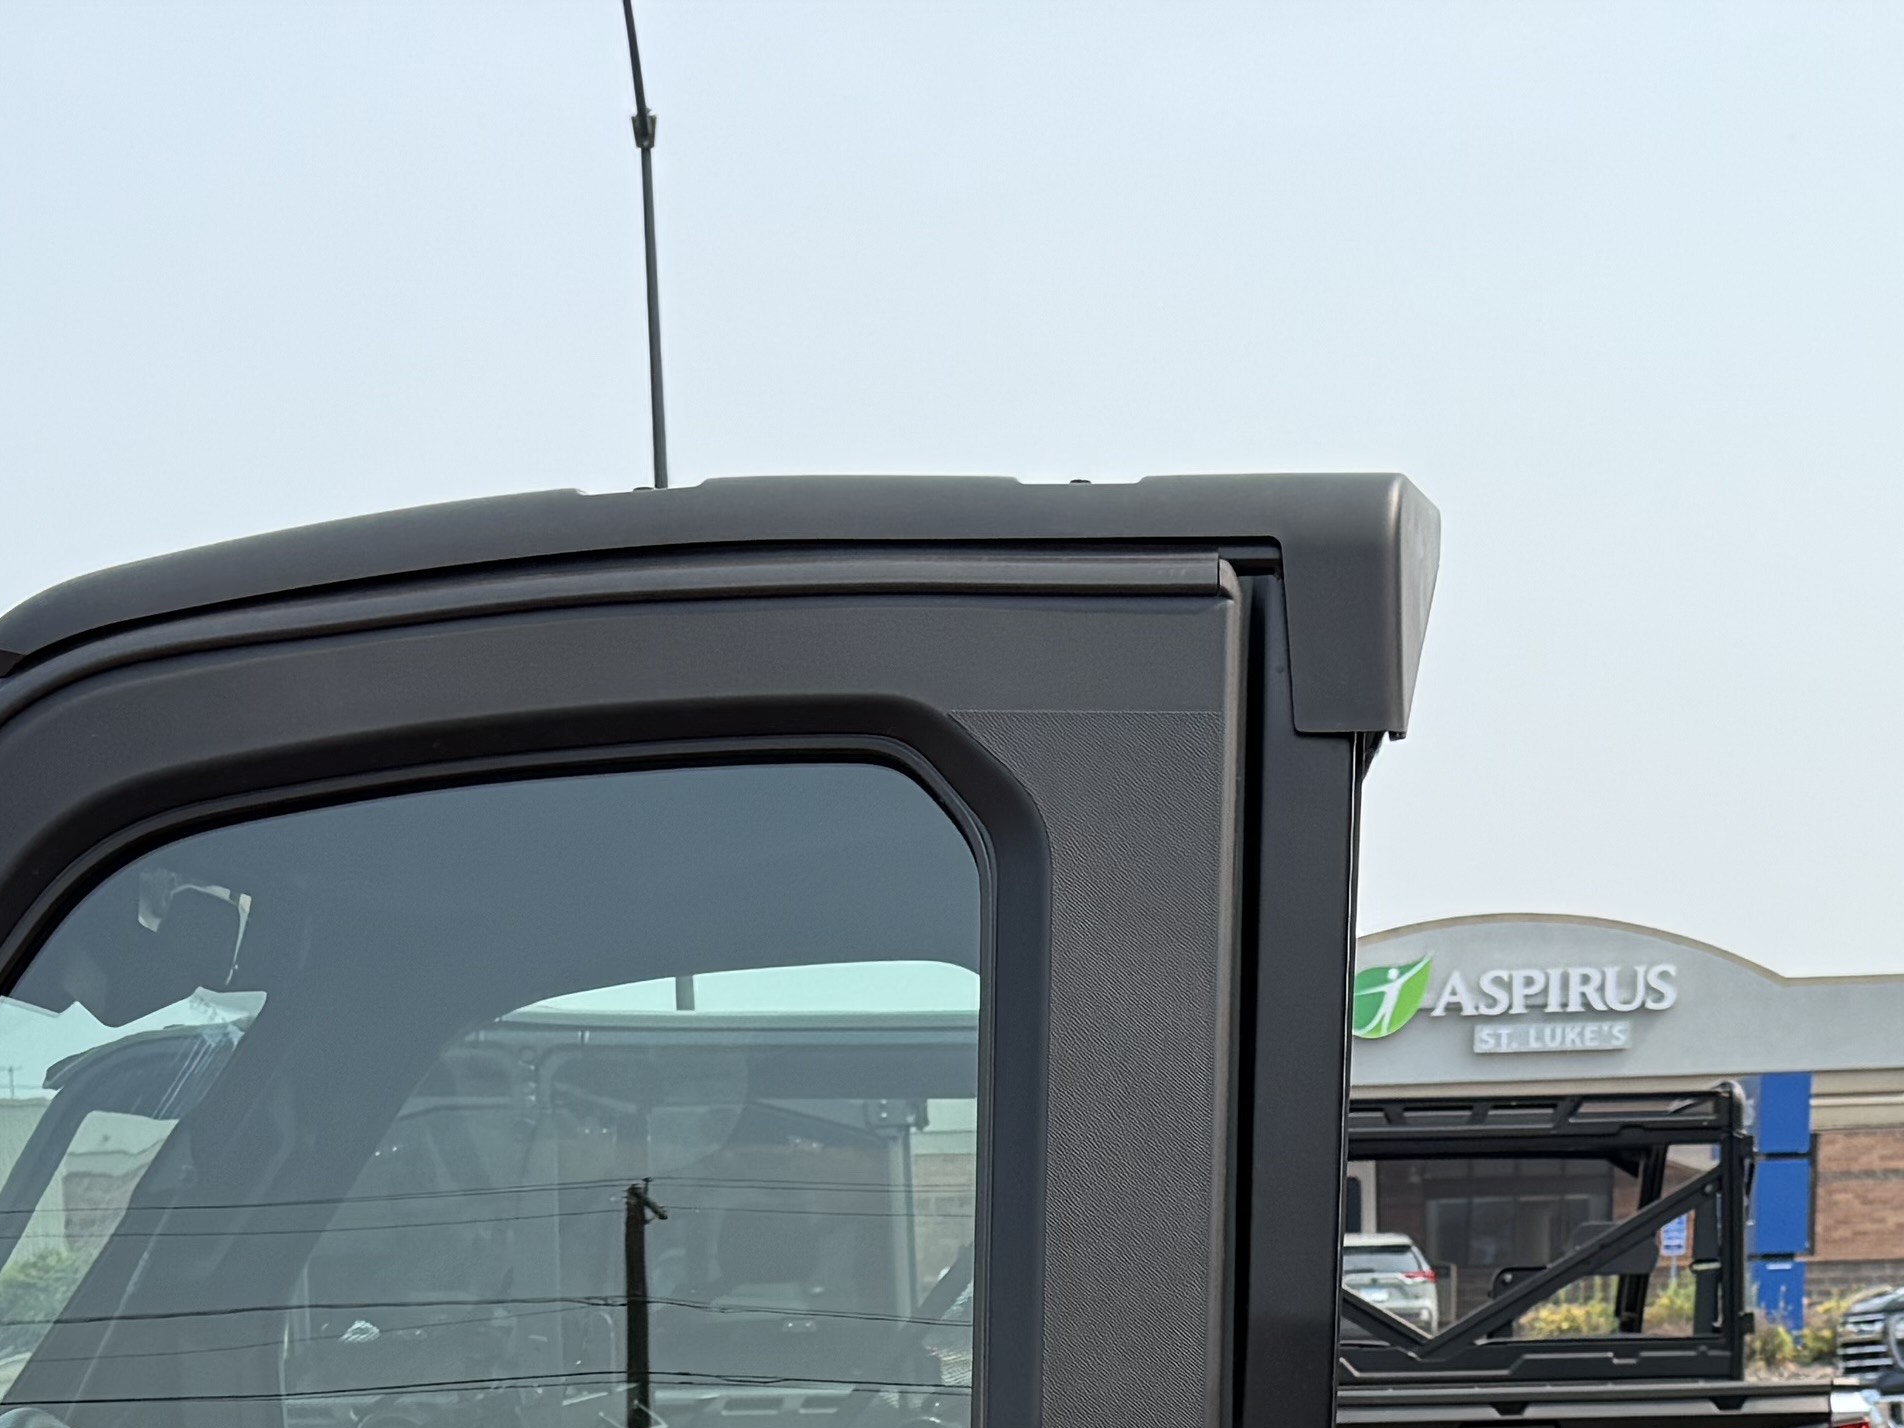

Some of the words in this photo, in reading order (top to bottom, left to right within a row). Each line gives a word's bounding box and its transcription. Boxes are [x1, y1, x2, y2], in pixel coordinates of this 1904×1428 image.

[1430, 963, 1678, 1017] ASPIRUS
[1478, 1029, 1519, 1049] ST.
[1528, 1023, 1629, 1049] LUKE'S
